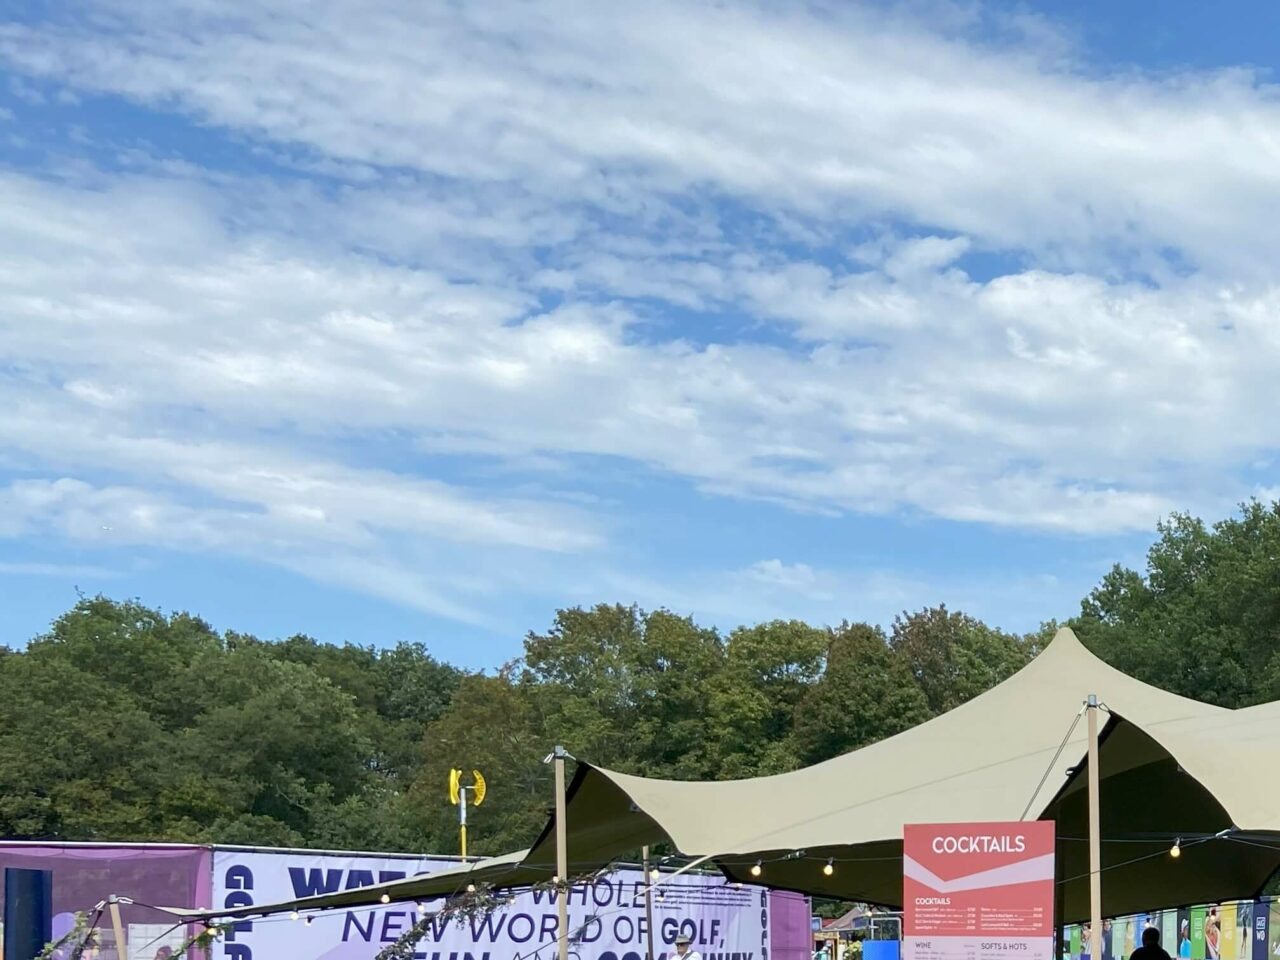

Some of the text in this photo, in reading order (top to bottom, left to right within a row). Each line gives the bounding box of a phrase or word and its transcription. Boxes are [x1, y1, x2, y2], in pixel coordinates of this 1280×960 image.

[932, 835, 1026, 854] COCKTAILS
[915, 897, 951, 905] COCKTAILS
[342, 911, 725, 949] NEW WORLD OF GOLF,
